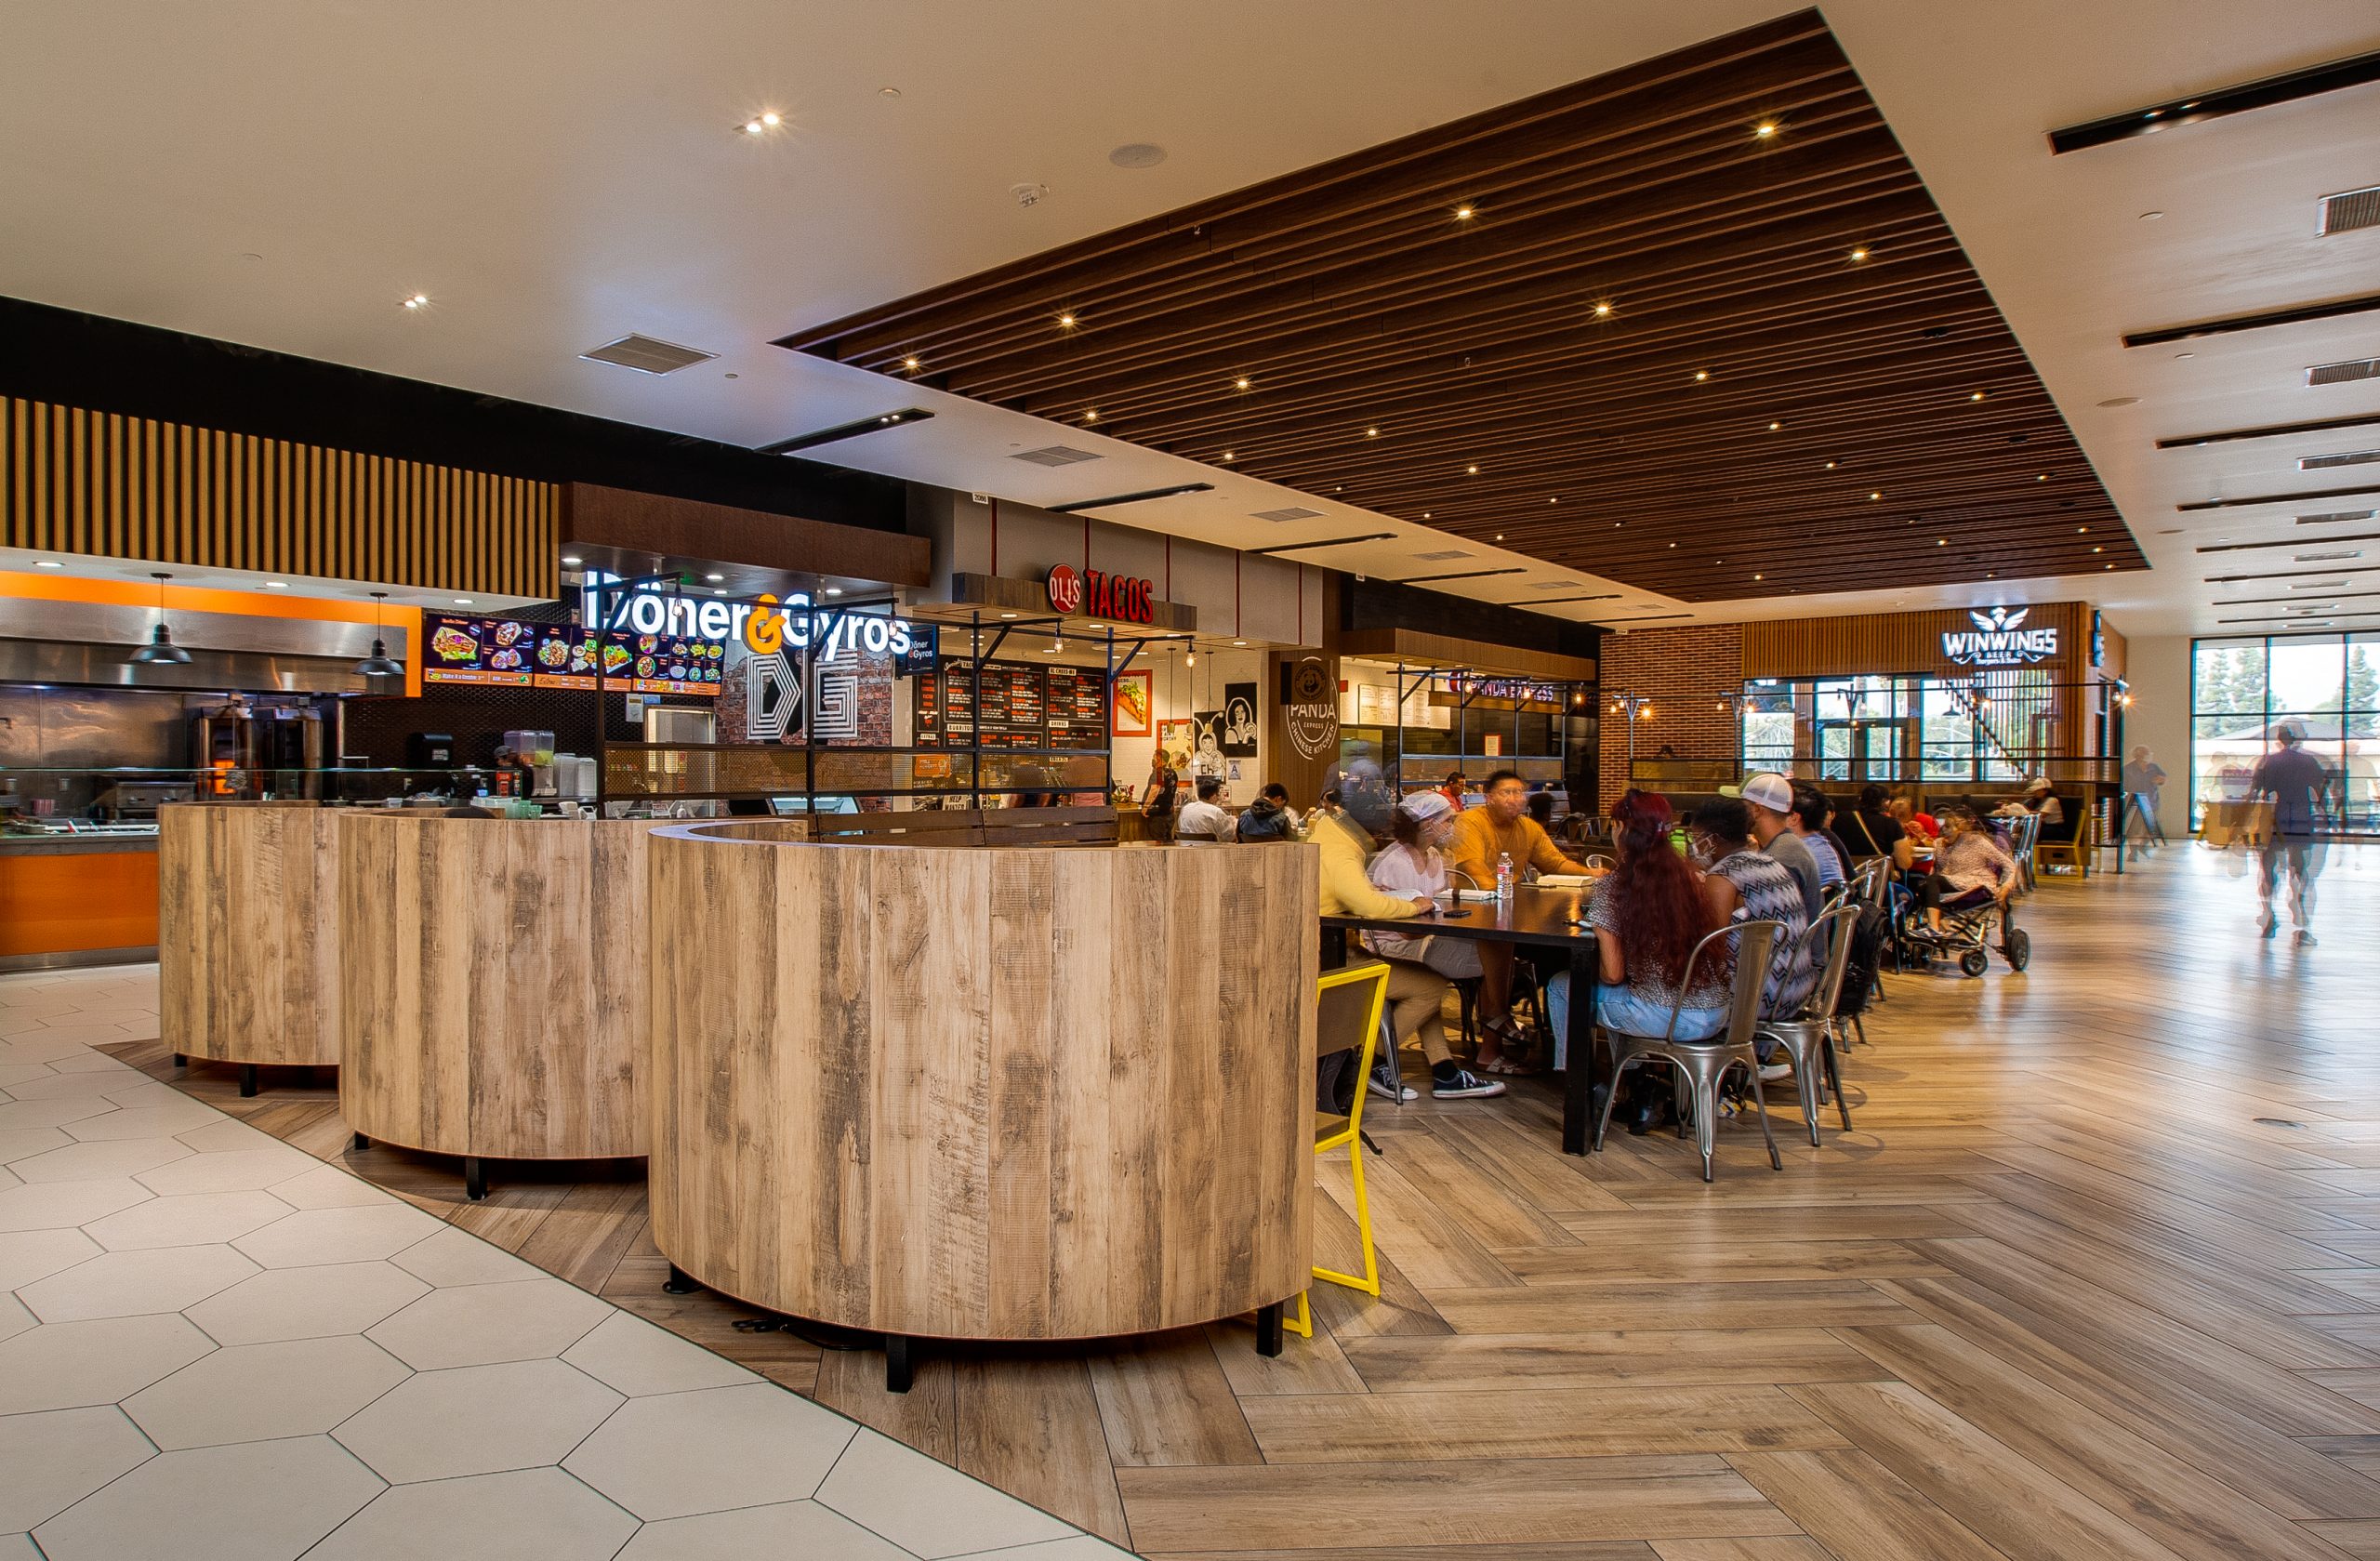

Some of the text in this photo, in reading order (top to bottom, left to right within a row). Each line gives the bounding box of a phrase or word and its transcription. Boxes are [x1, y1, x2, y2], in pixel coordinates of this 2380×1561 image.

[1049, 569, 1153, 624] OLI'S TACOS
[1942, 628, 2057, 657] WINWINGS
[1290, 704, 1337, 719] PANDA
[1290, 721, 1335, 754] CHINESE KITCHEN
[1231, 764, 1238, 774] A
